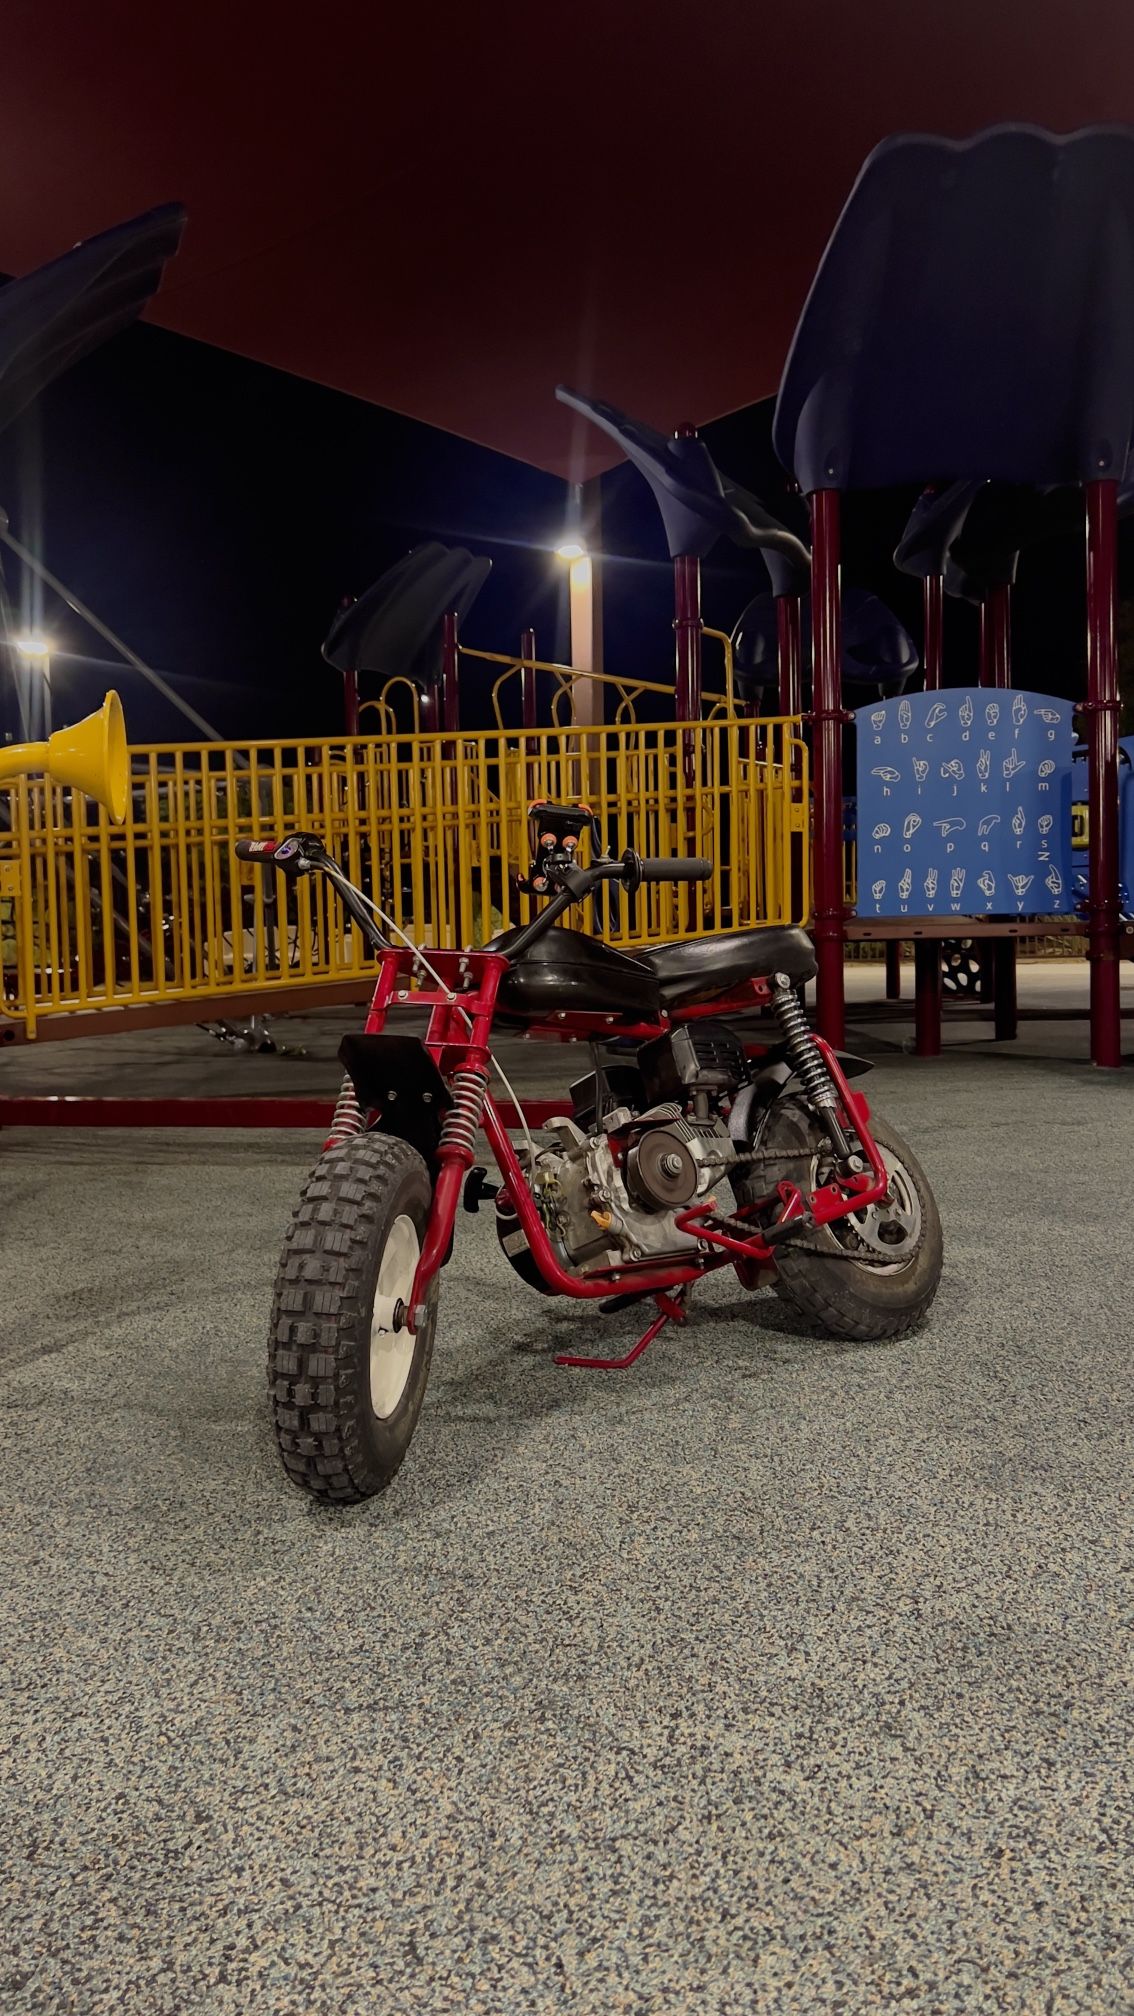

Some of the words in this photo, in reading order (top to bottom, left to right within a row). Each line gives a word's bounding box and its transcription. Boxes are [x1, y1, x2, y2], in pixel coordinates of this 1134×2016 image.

[874, 736, 881, 745] a
[901, 733, 909, 743] b
[926, 734, 933, 742] c
[962, 730, 969, 741] d
[988, 731, 996, 740] e
[1014, 728, 1020, 739] f
[1047, 730, 1055, 741] g
[883, 786, 891, 796] h
[981, 782, 987, 793] k
[1038, 782, 1049, 791] m
[874, 845, 881, 853] n
[903, 844, 911, 852] o
[947, 842, 955, 853] p
[981, 841, 989, 852] q
[1016, 841, 1022, 849] r
[1041, 839, 1048, 848] s
[875, 903, 881, 913] t
[900, 904, 908, 913] u
[950, 903, 961, 911] w
[986, 902, 993, 910] x
[1017, 901, 1024, 912] y
